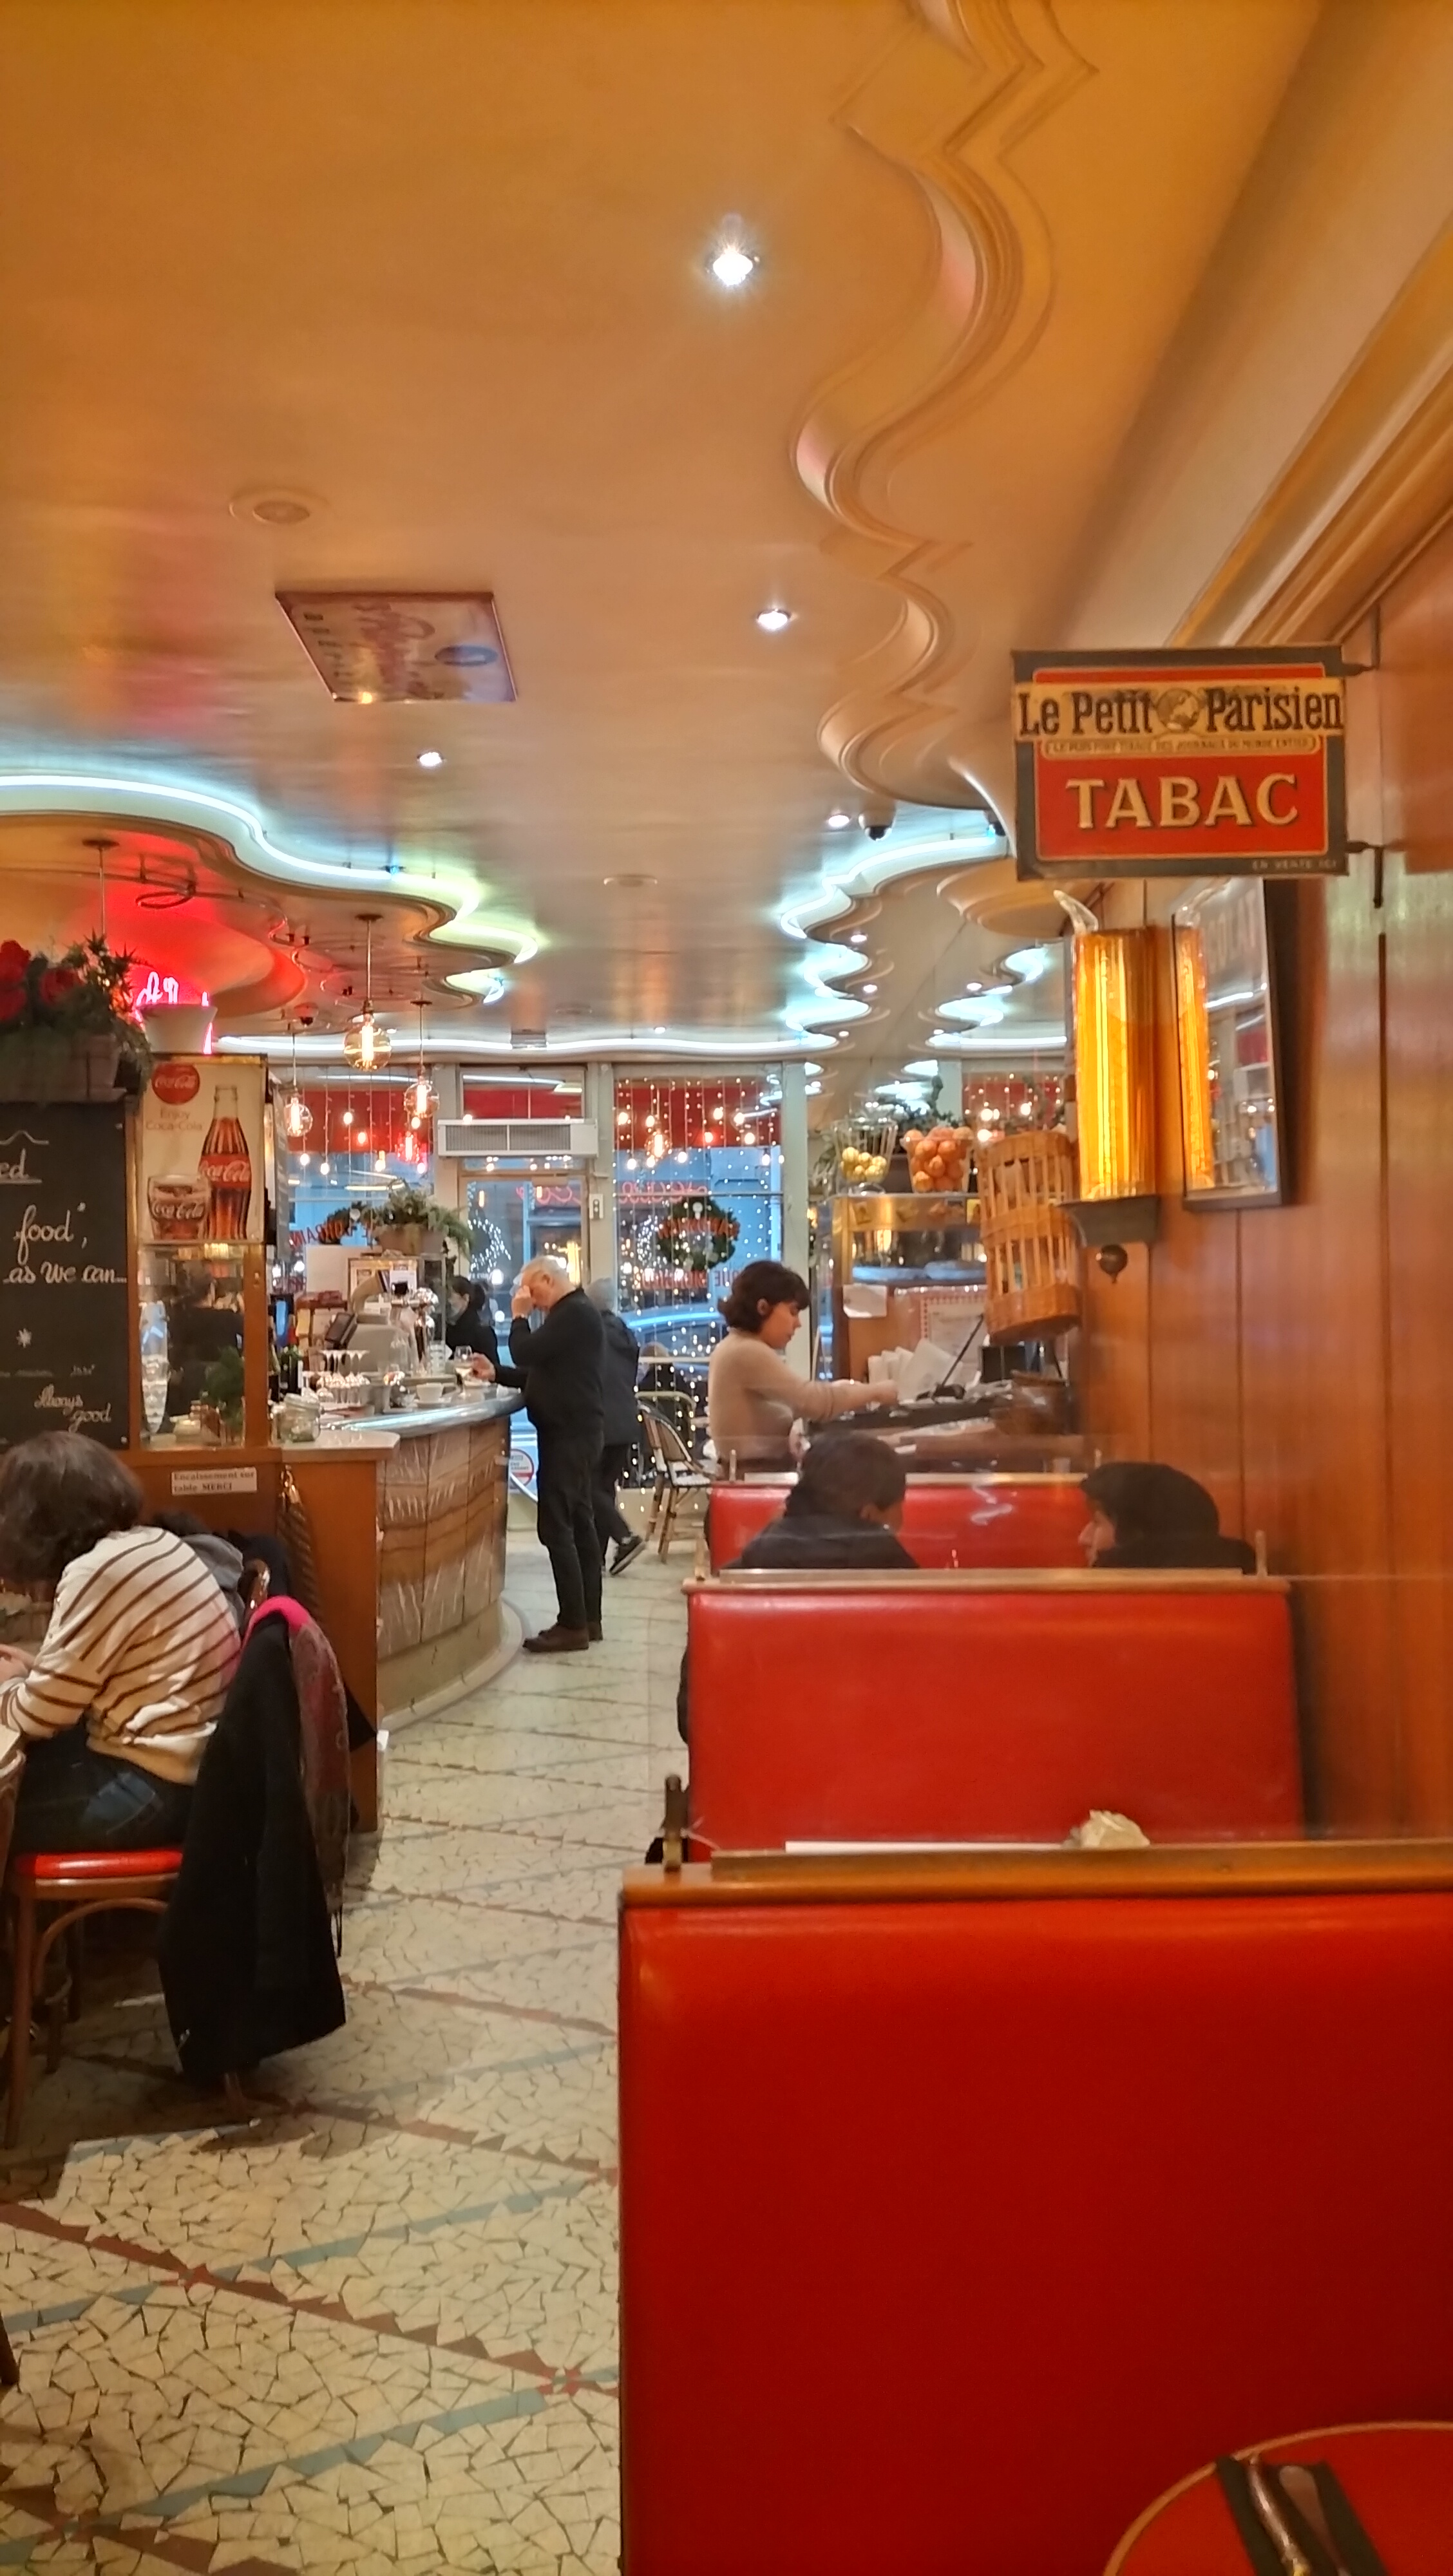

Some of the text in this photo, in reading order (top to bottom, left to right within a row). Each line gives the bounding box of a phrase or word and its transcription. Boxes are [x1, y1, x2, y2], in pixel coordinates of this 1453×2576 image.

[1018, 685, 1344, 735] Le Petit Parisien
[1066, 773, 1298, 829] TABAC
[146, 1121, 202, 1131] Coca-Cola
[160, 1109, 190, 1121] Enjoy
[34, 1384, 84, 1416] Always
[68, 1403, 111, 1434] good
[174, 1482, 232, 1492] table MERCI
